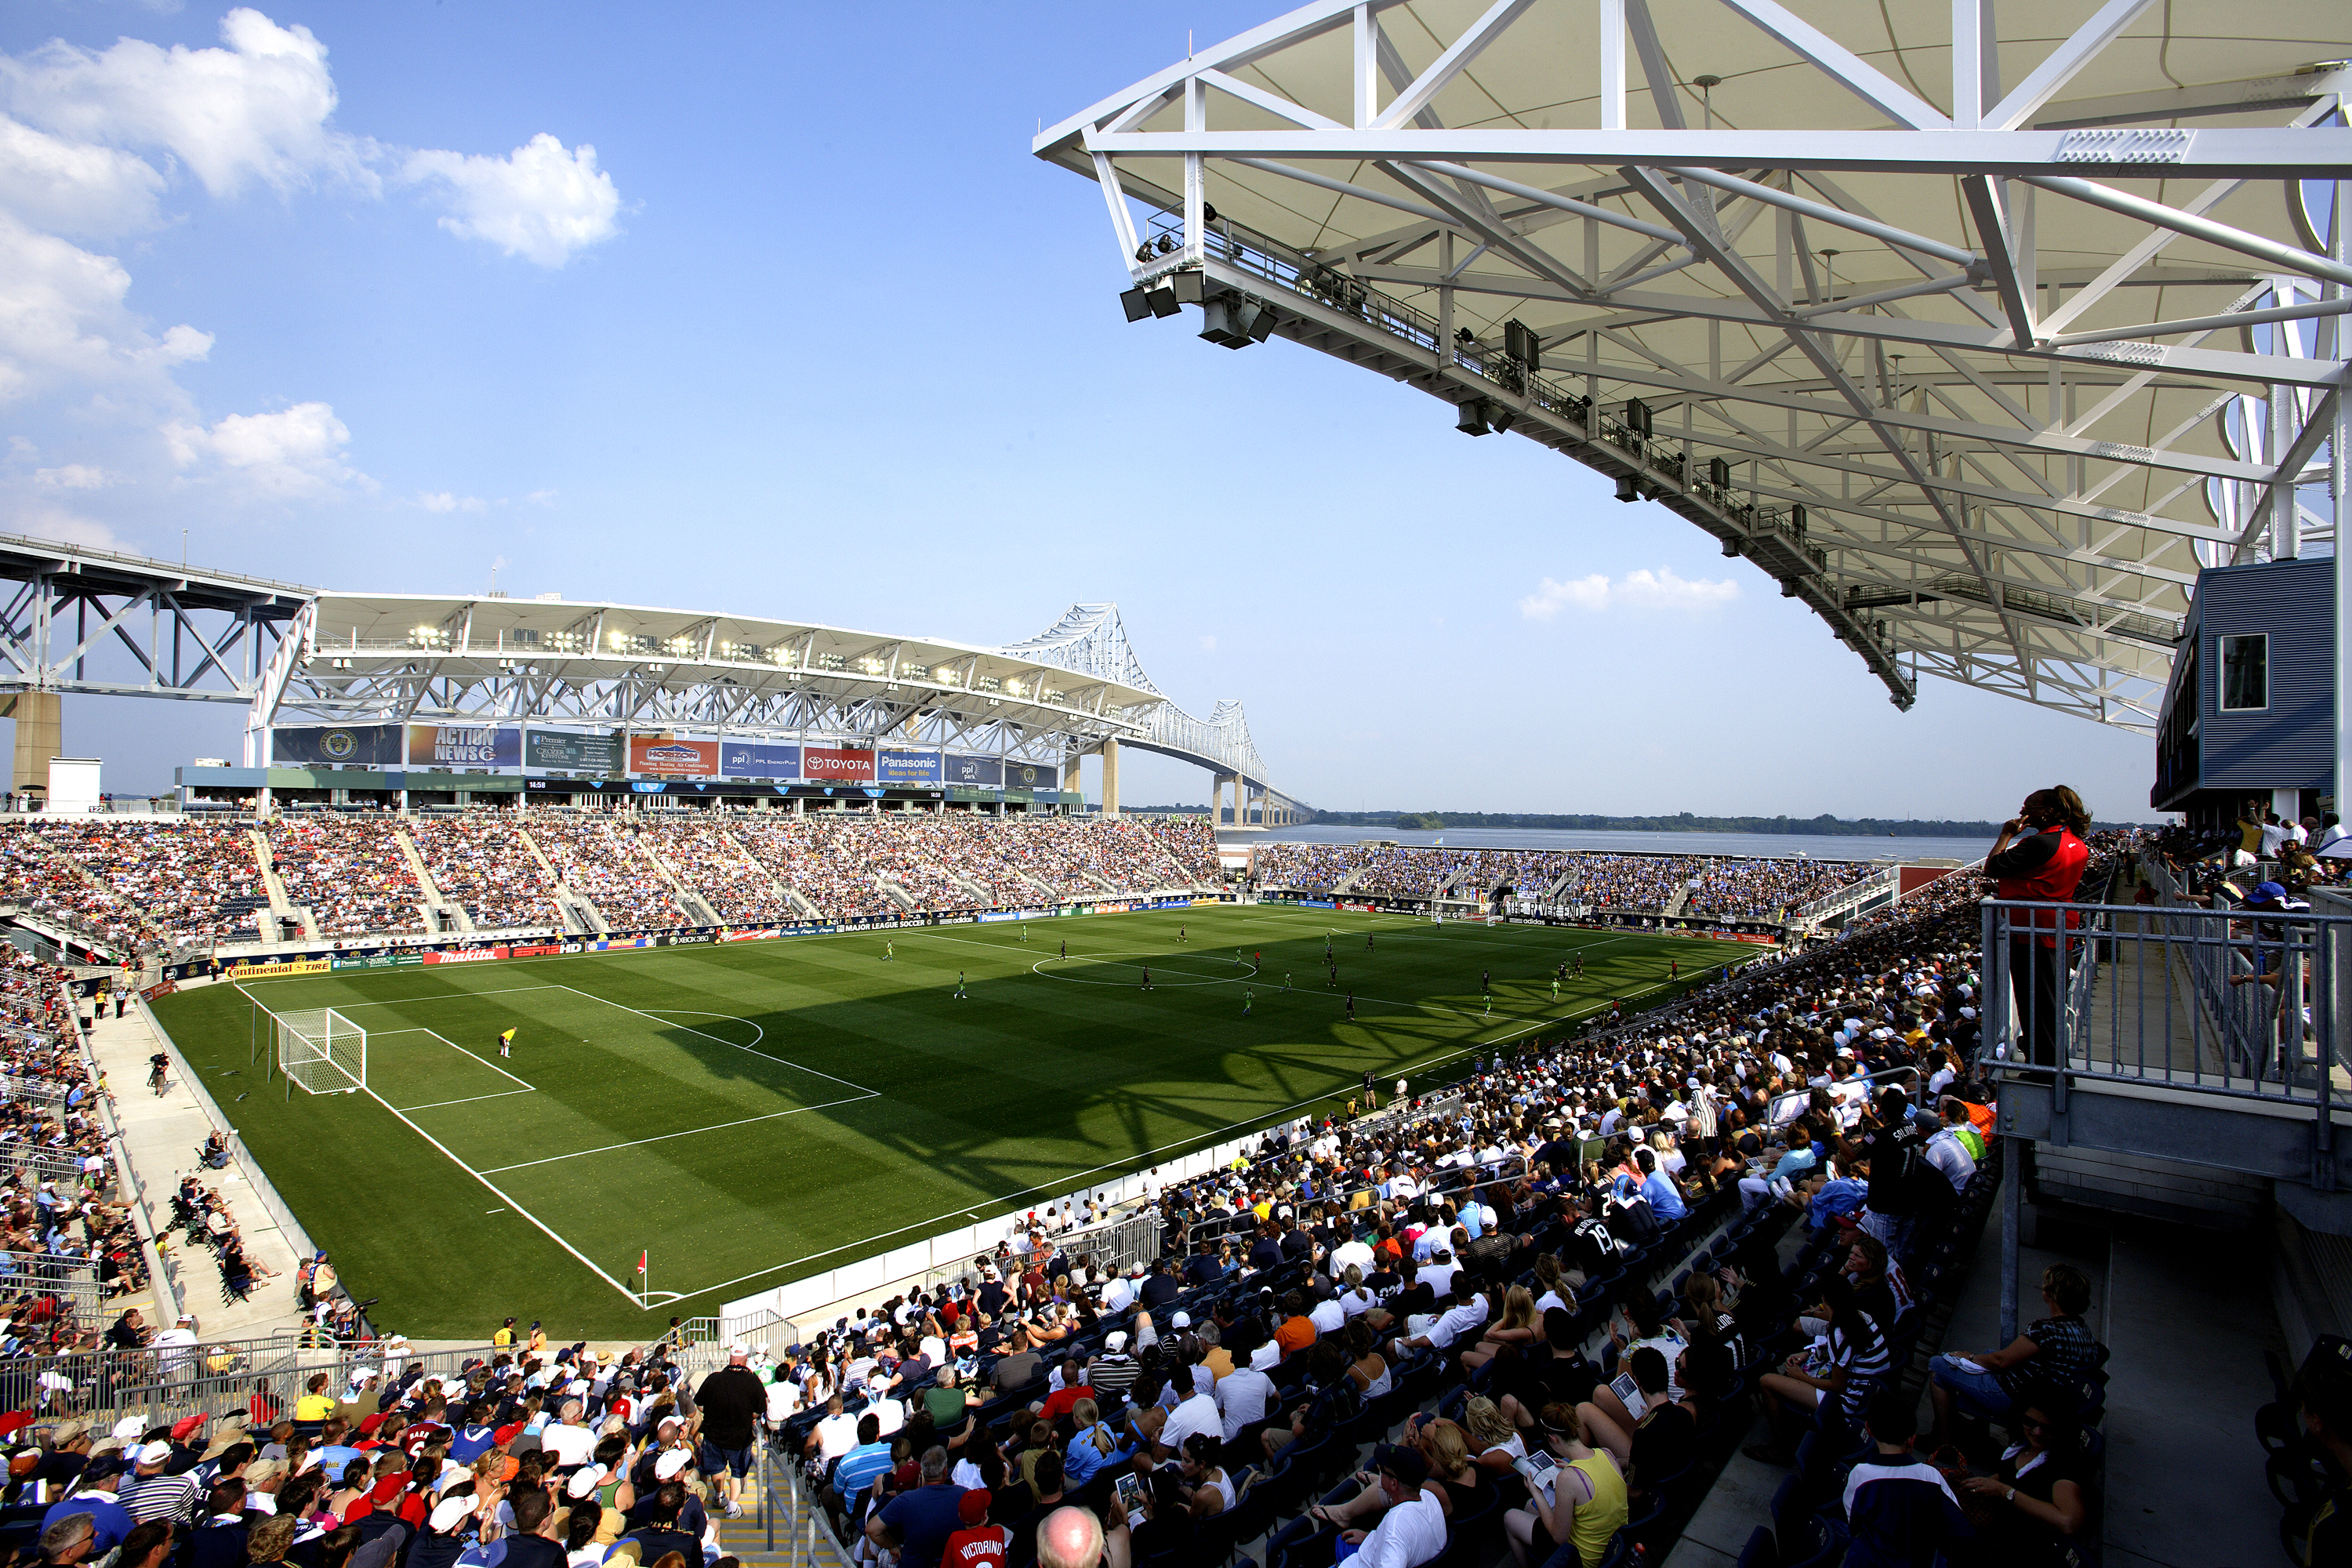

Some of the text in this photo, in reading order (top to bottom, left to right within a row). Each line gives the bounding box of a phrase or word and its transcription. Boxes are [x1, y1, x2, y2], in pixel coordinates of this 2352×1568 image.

[321, 729, 356, 745] PHILADELPHIA
[435, 728, 495, 746] ACTION
[434, 746, 496, 761] NEWS 6
[648, 750, 698, 759] HORIZON
[732, 754, 746, 764] ppl
[825, 758, 871, 770] TOYOTA
[881, 756, 936, 768] Panasonic
[961, 764, 974, 775] ppl
[1341, 903, 1369, 913] makita
[1508, 901, 1582, 919] THE RIVER END
[953, 916, 974, 924] adidas
[982, 912, 1017, 922] Panasonic
[845, 919, 925, 932] MAJOR LEAGUE SOCCER
[695, 935, 710, 943] 360
[724, 929, 763, 942] Budweiser
[437, 948, 498, 964] makita
[227, 964, 292, 978] Continental
[1893, 1124, 1918, 1142] SALINAS
[1322, 1142, 1327, 1150] 5
[1588, 1224, 1613, 1255] 19
[960, 1539, 1003, 1560] VICTORINO
